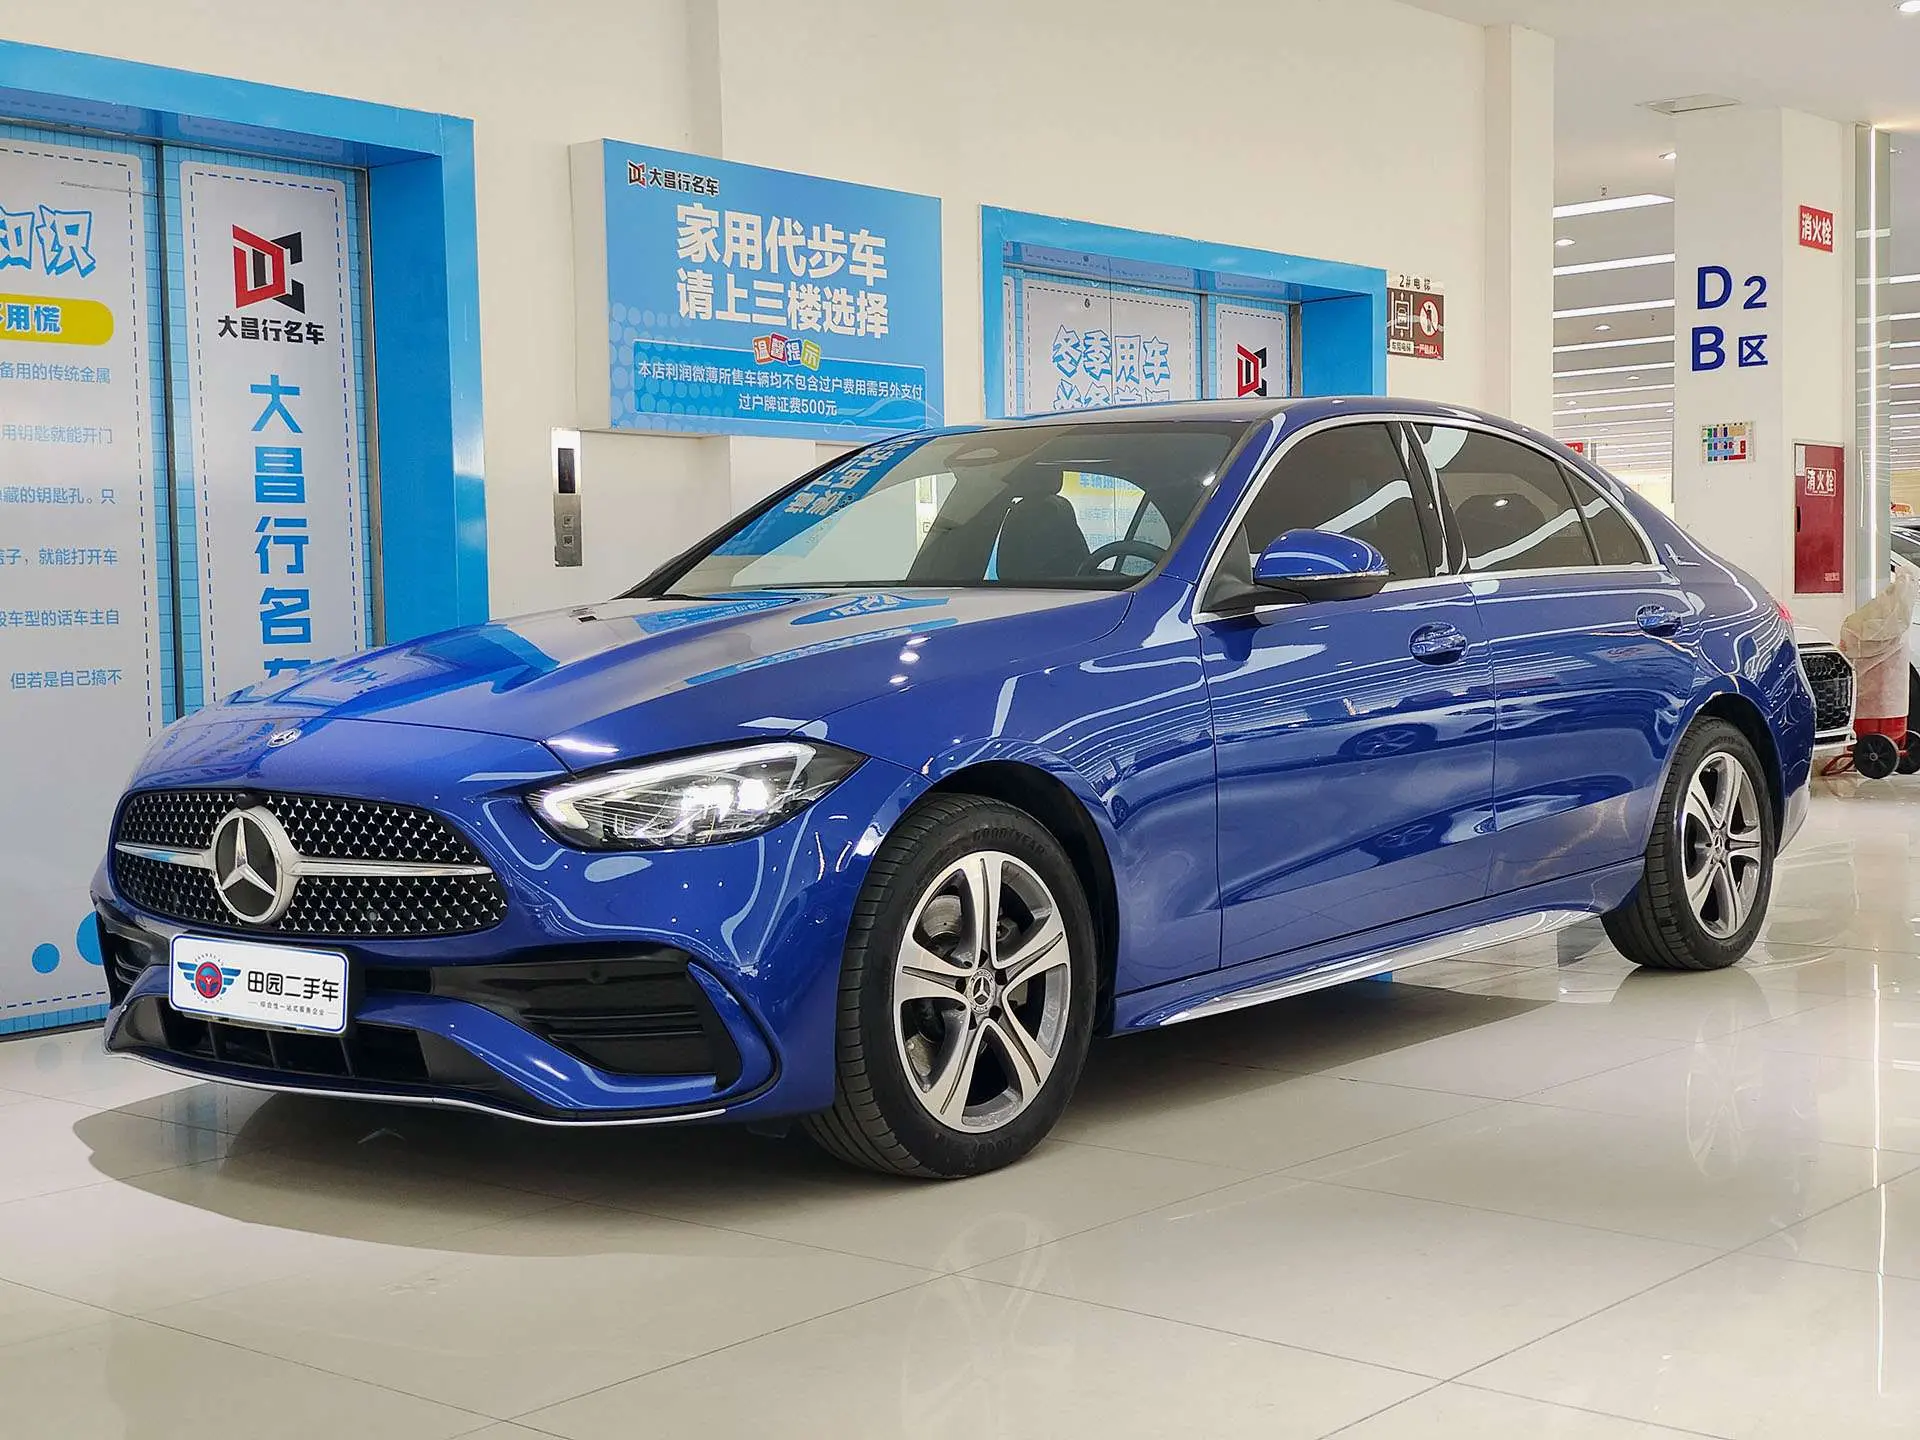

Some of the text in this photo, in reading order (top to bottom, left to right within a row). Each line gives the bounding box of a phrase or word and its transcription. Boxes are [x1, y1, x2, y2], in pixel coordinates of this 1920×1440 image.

[649, 168, 719, 196] 大昌行名车
[1801, 212, 1832, 246] 消火栓
[676, 202, 888, 287] 家用代步车
[676, 267, 889, 338] 请上三楼选择
[0, 303, 61, 333] 用慌
[218, 314, 325, 345] 大昌行名车
[1052, 324, 1170, 386] 冬季用车
[0, 361, 111, 384] 备用的传统金属
[638, 361, 923, 400] 本店利润微薄所售车辆均不包含过户费用需另外支付
[739, 393, 838, 416] 过户牌证费500元
[2, 424, 113, 445] 用钥匙就能开门
[1807, 468, 1834, 492] 消火栓
[0, 486, 116, 505] 藏的钥匙孔。只
[11, 669, 122, 690] 但若是自己搞不
[248, 970, 340, 1002] 田园二手车
